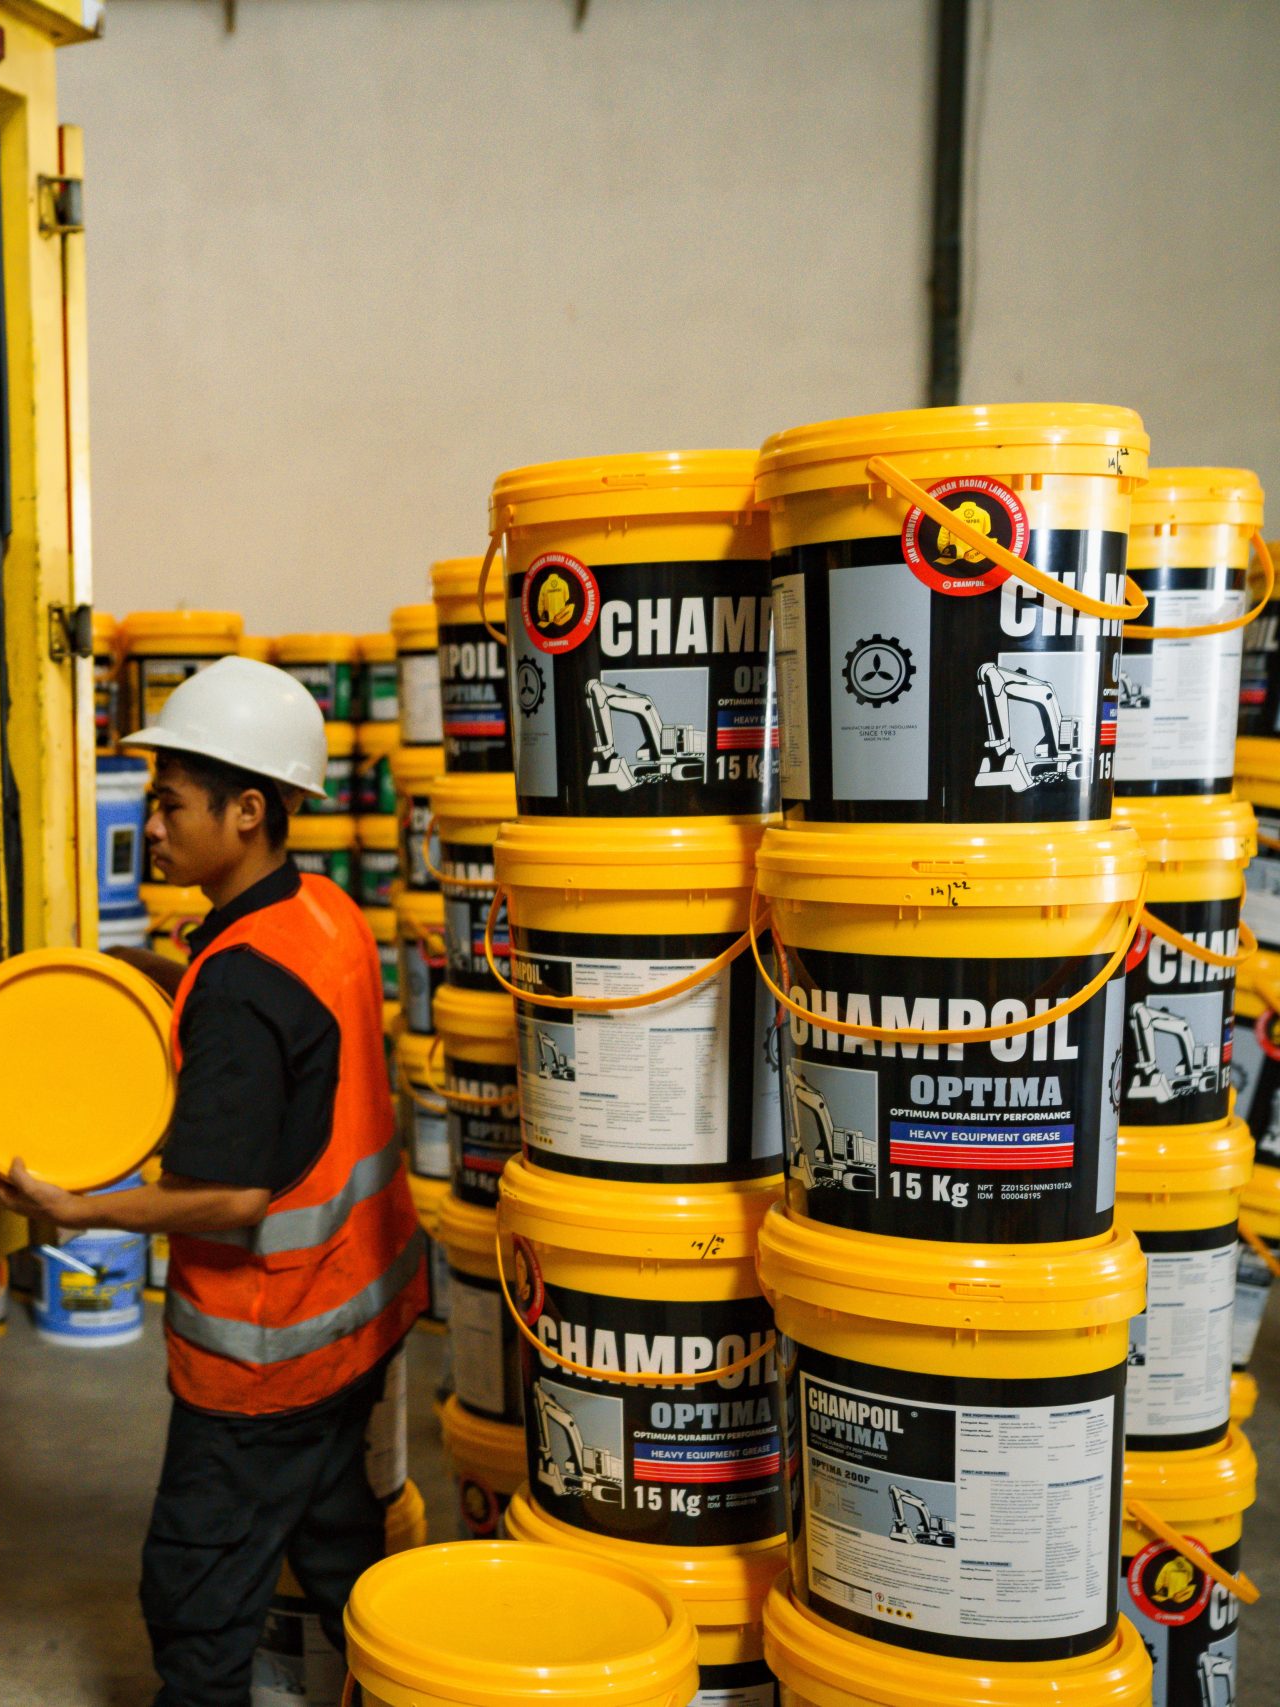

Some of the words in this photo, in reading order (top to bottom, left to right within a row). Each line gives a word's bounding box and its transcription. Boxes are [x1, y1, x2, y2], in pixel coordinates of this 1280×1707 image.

[929, 481, 957, 499] MUKAN
[959, 479, 988, 489] HADIAH
[988, 483, 1019, 513] LANGSUNG
[905, 506, 923, 547] BERUNTUN
[1013, 512, 1023, 522] DI
[1012, 522, 1025, 558] DALAMN
[716, 755, 741, 781] 15
[789, 985, 1078, 1062] CHAMPOIL
[910, 1075, 1063, 1107] OPTIMA
[890, 1108, 940, 1120] OPTIMUM
[941, 1110, 1002, 1121] DURABILITY
[1003, 1111, 1072, 1121] PERFORMANCE
[909, 1129, 948, 1141] HEAVY
[951, 1131, 1020, 1142] EQUIPMENT
[1022, 1132, 1061, 1142] GREASE
[889, 1170, 922, 1200] 15
[932, 1174, 970, 1208] Kg
[1001, 1192, 1041, 1200] 000048195
[537, 1314, 779, 1391] CHAMPOIL
[651, 1397, 772, 1429] OPTIMA
[808, 1387, 904, 1434] CHAMPOIL
[633, 1430, 677, 1441] OPTIMUM
[677, 1433, 726, 1442] DURABILITY
[727, 1425, 778, 1440] PERFORMANCE
[809, 1410, 889, 1452] OPTIMA
[651, 1449, 684, 1459] HEAVY
[686, 1450, 741, 1460] EQUIPMENT
[742, 1444, 771, 1456] GREASE
[812, 1457, 842, 1476] OPTIMA
[845, 1470, 871, 1484] 200F
[633, 1485, 662, 1511] 15
[670, 1488, 702, 1517] Kg
